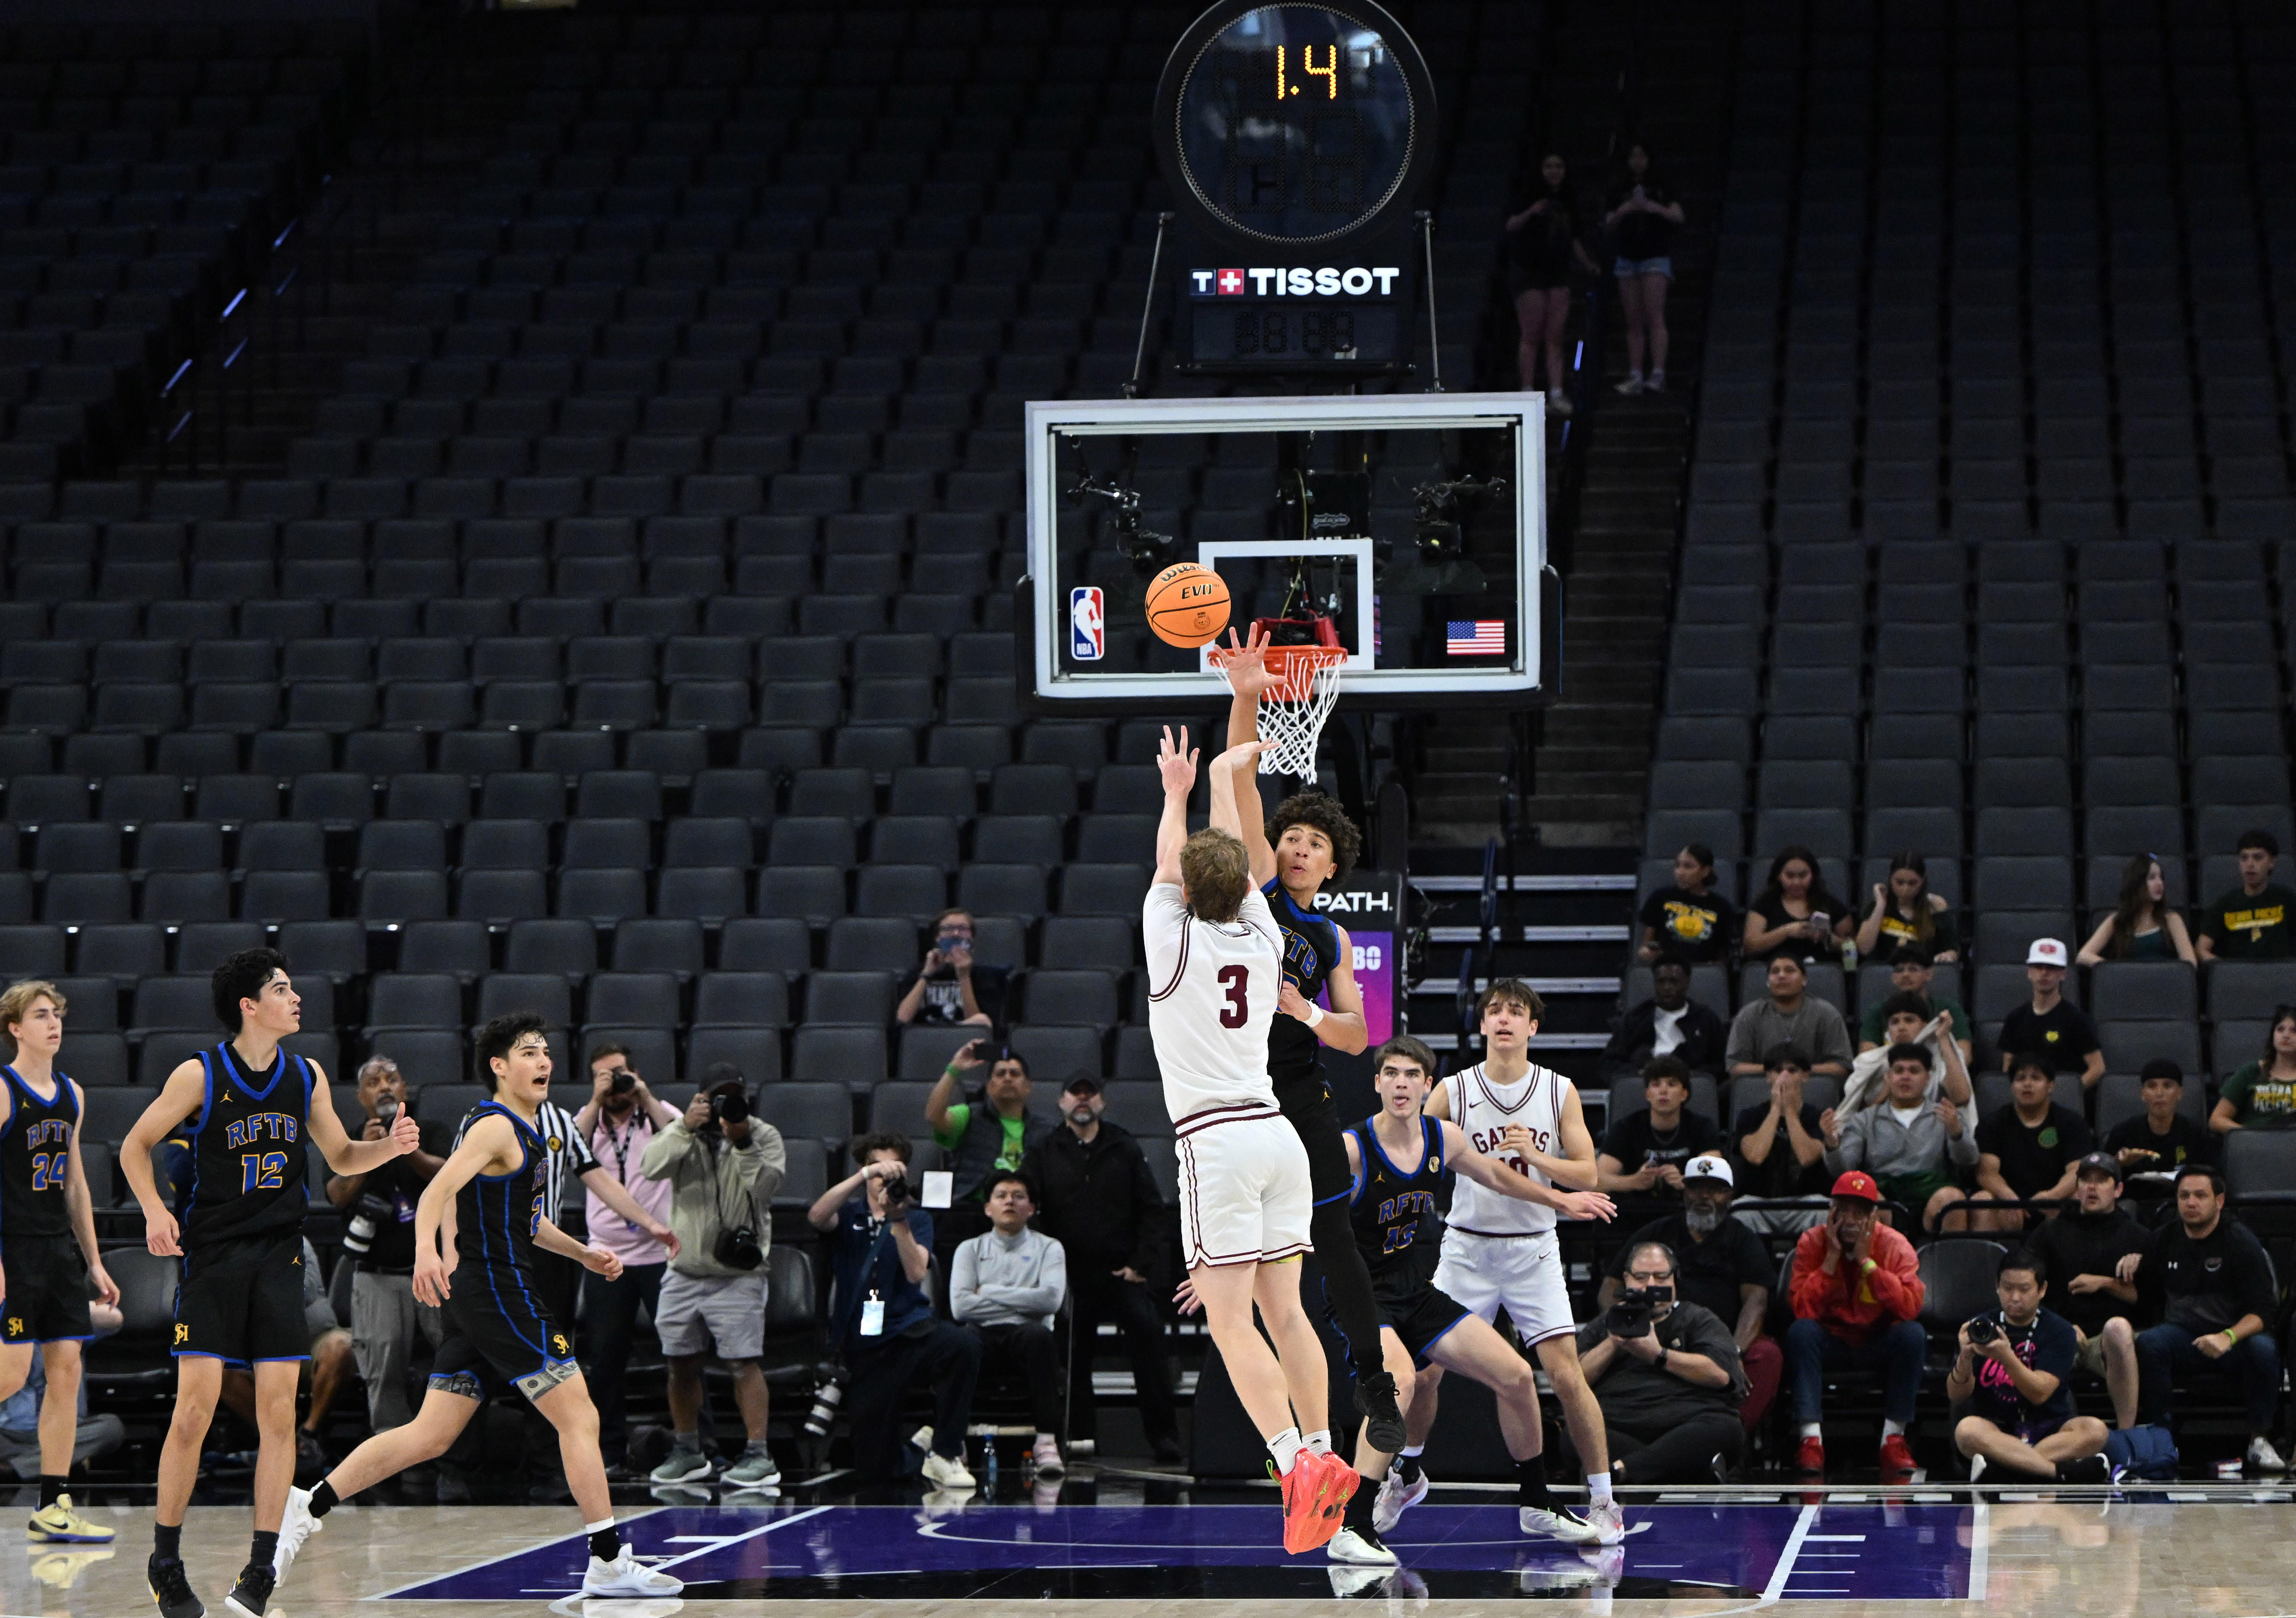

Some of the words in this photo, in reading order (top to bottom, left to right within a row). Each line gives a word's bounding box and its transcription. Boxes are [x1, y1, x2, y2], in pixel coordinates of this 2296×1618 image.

[1278, 45, 1336, 100] 1.4
[1248, 267, 1400, 296] TISSOT
[1181, 583, 1212, 599] EVO
[1077, 643, 1092, 655] NBA
[1217, 965, 1249, 1029] 3
[225, 1112, 297, 1150] RFTB
[1472, 1125, 1550, 1154] GATRS
[32, 1152, 67, 1191] 24
[241, 1151, 288, 1195] 12
[1498, 1156, 1529, 1178] 0
